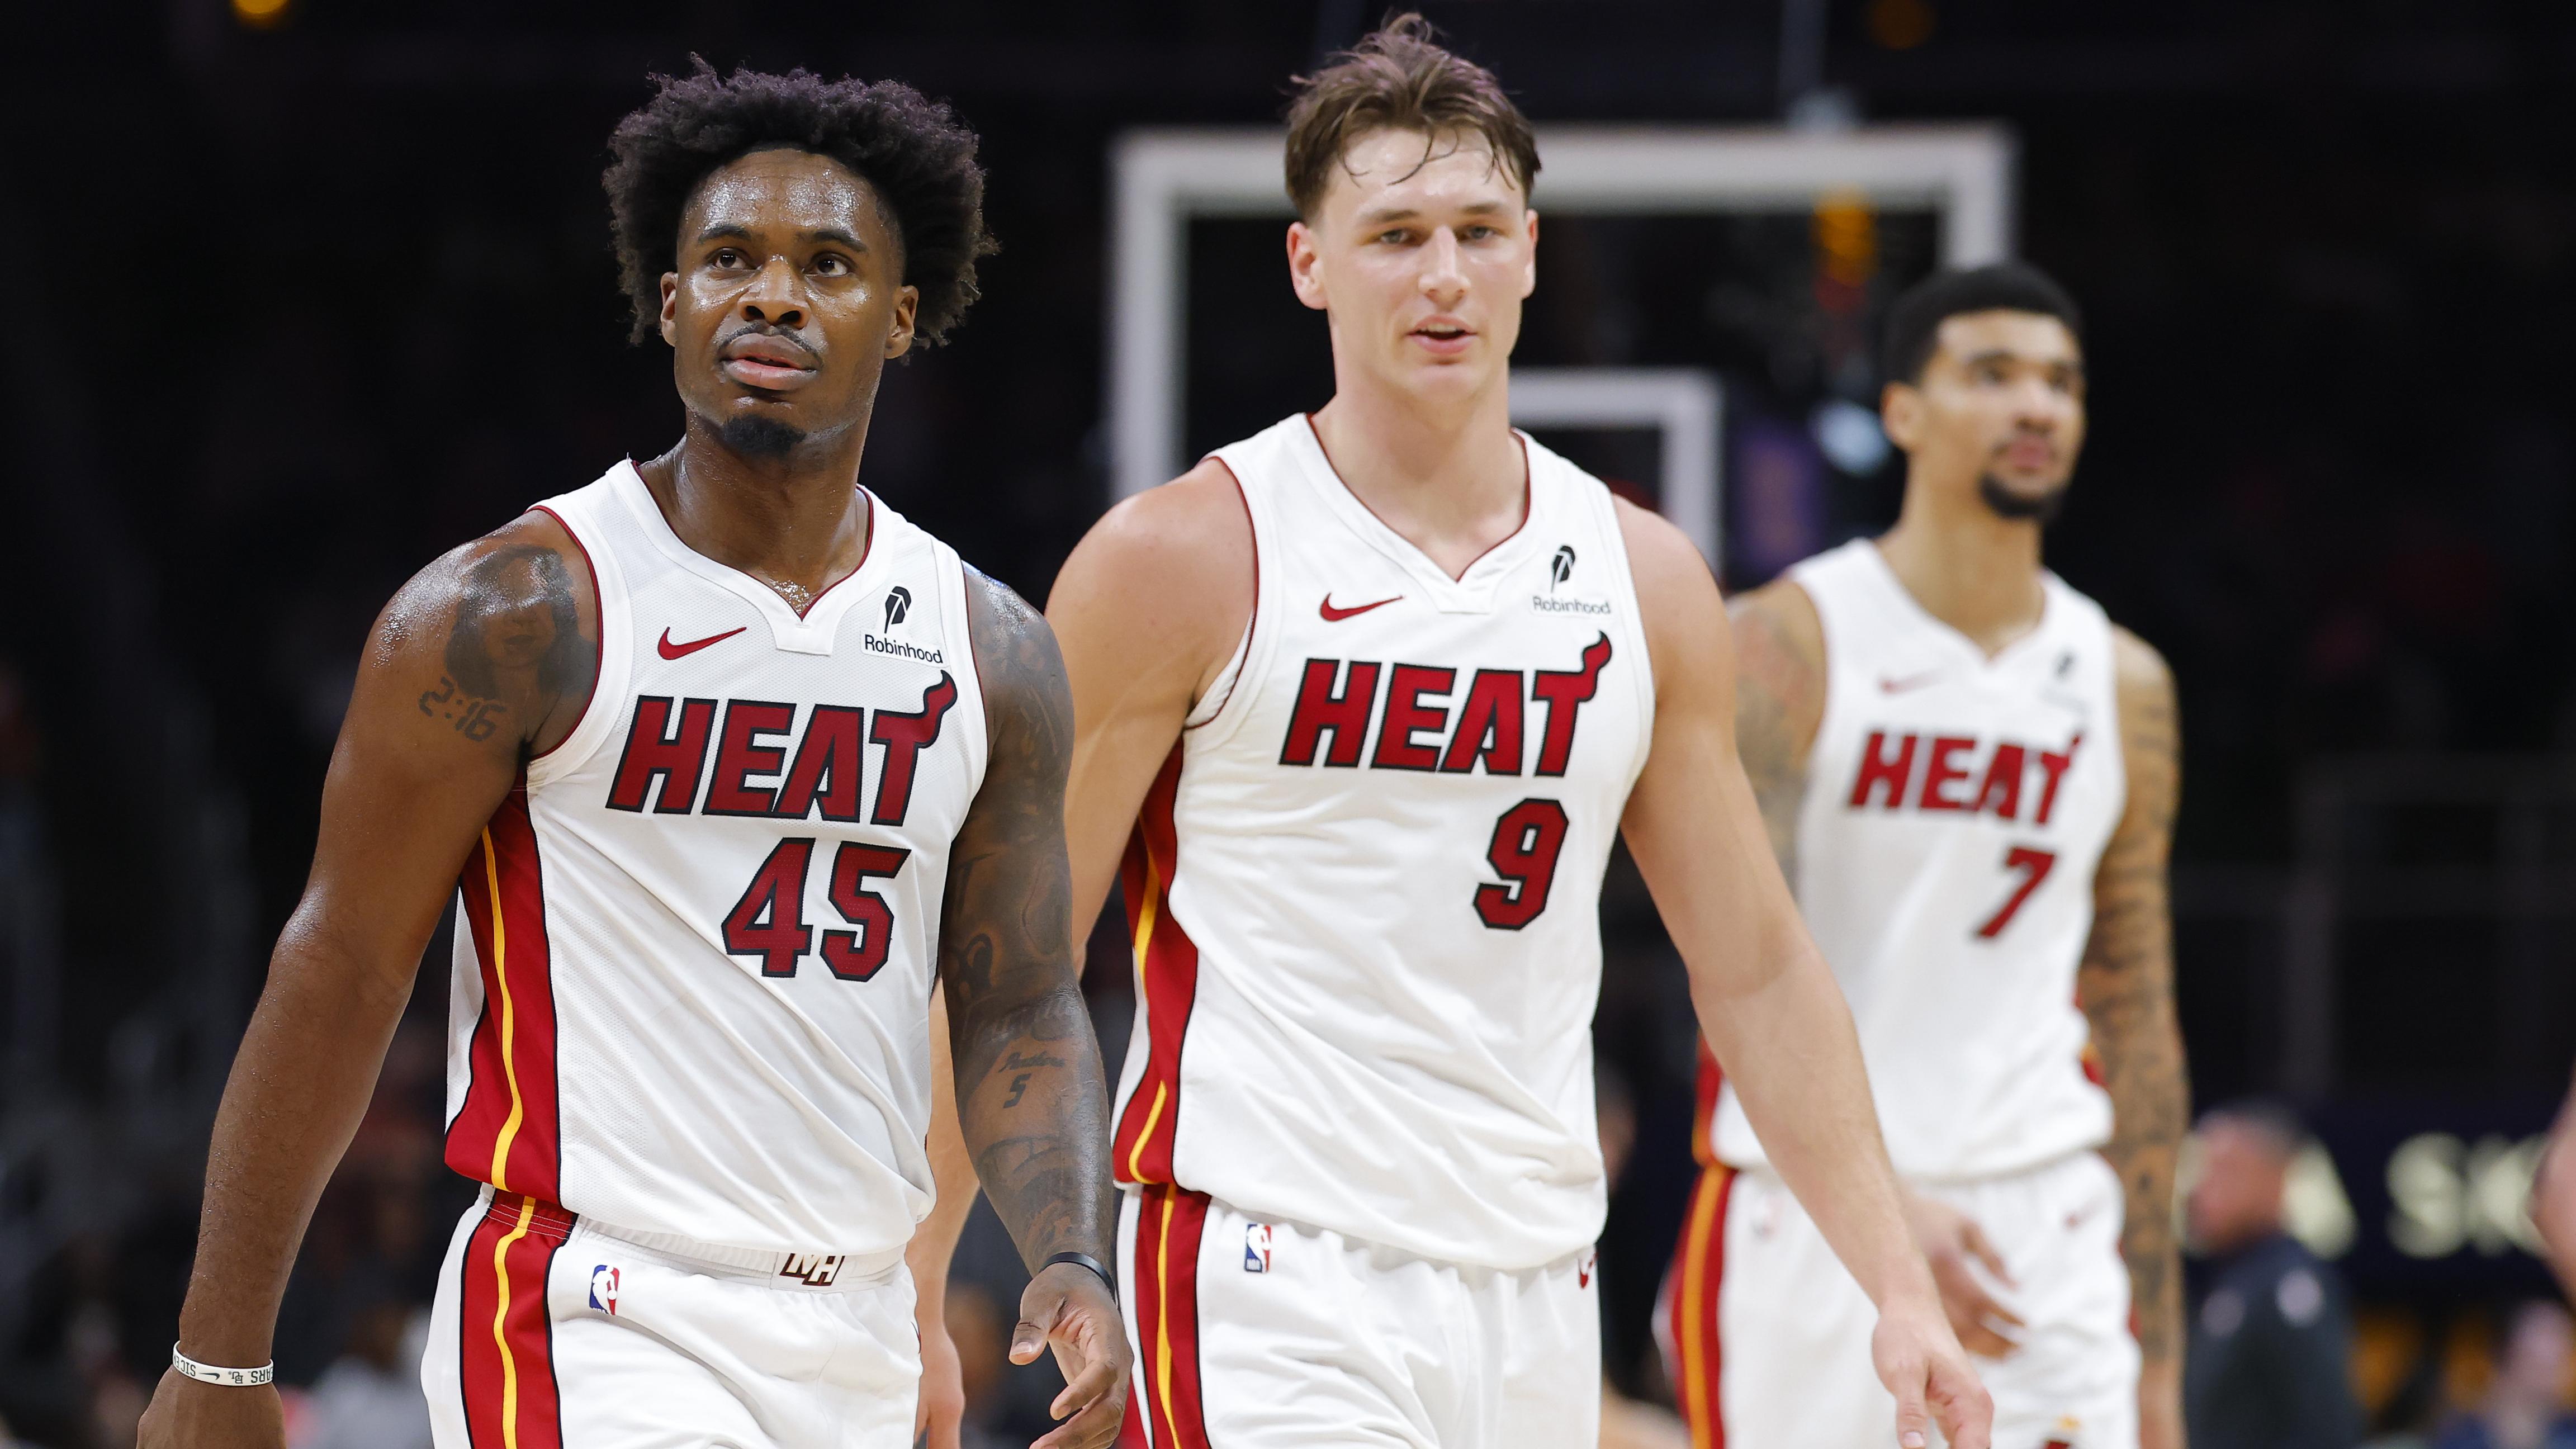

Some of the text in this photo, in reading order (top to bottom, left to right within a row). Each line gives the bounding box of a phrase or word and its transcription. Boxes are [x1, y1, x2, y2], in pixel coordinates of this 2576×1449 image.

[864, 634, 943, 664] Robinhood
[1533, 595, 1611, 614] Robinhood
[419, 676, 507, 742] 2:16
[605, 670, 957, 827] HEAT
[1278, 630, 1612, 777] HEAT
[1845, 728, 2085, 827] HEAT
[721, 837, 911, 982] 45
[1473, 797, 1569, 931] 9
[1973, 844, 2059, 941] 7
[1002, 1073, 1033, 1109] 5
[181, 1360, 196, 1377] SIC
